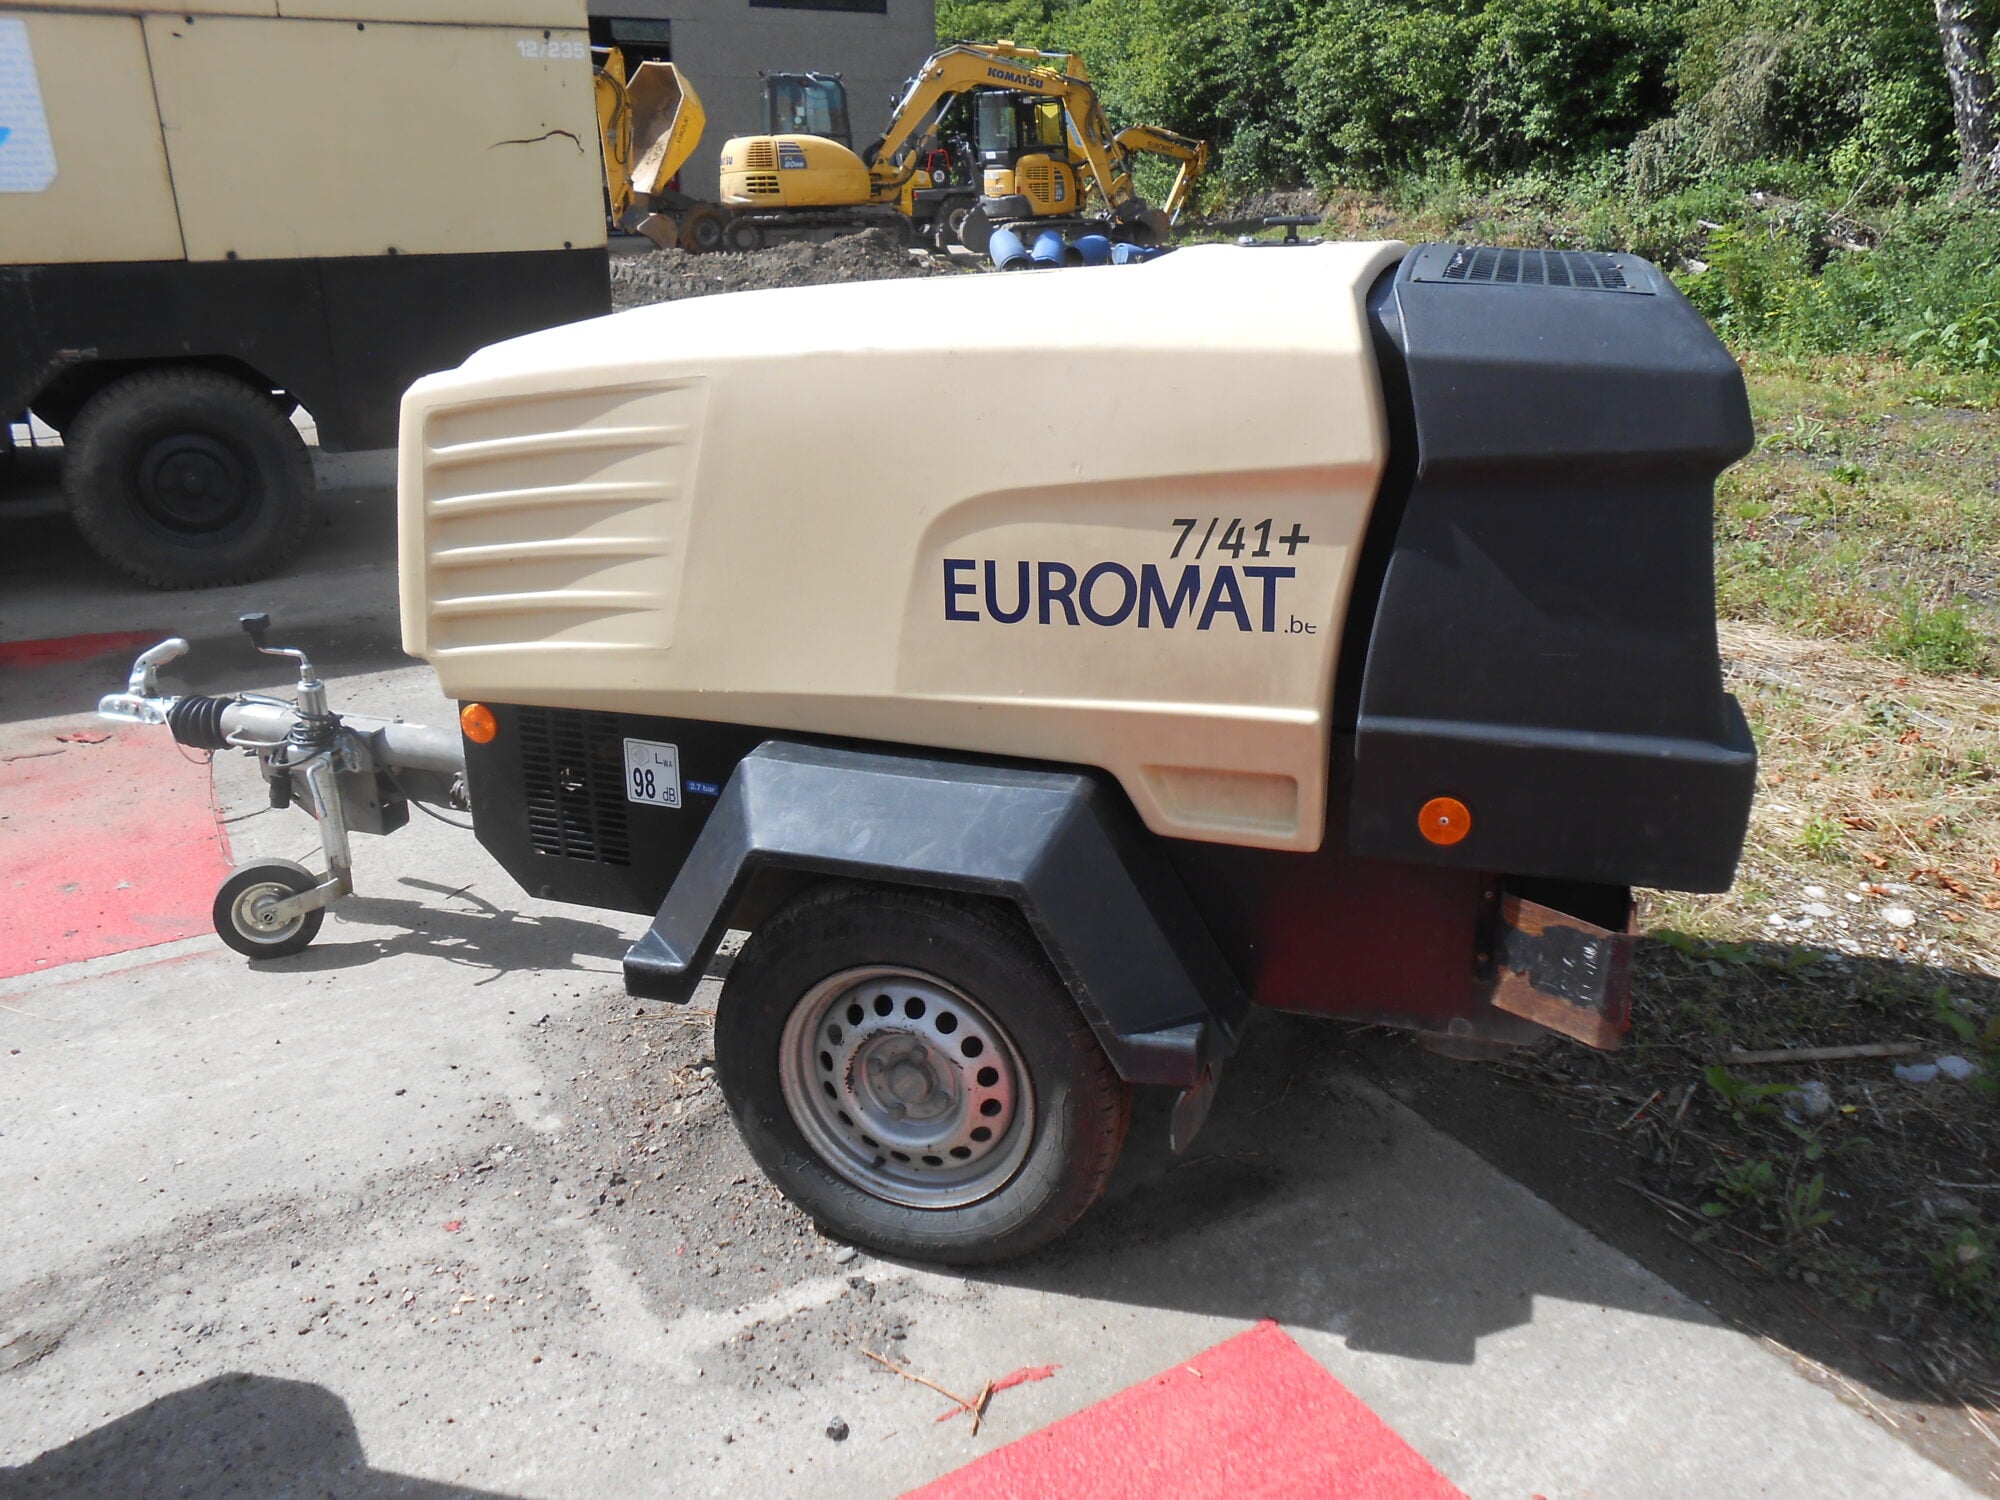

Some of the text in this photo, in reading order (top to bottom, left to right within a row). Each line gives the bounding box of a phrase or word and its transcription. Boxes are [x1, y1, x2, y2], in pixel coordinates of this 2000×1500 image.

[517, 40, 585, 58] 12/235
[987, 67, 1044, 88] KOMATSU
[1170, 517, 1310, 559] 7/41+
[633, 767, 676, 802] 98 dB
[689, 782, 701, 791] 2.7
